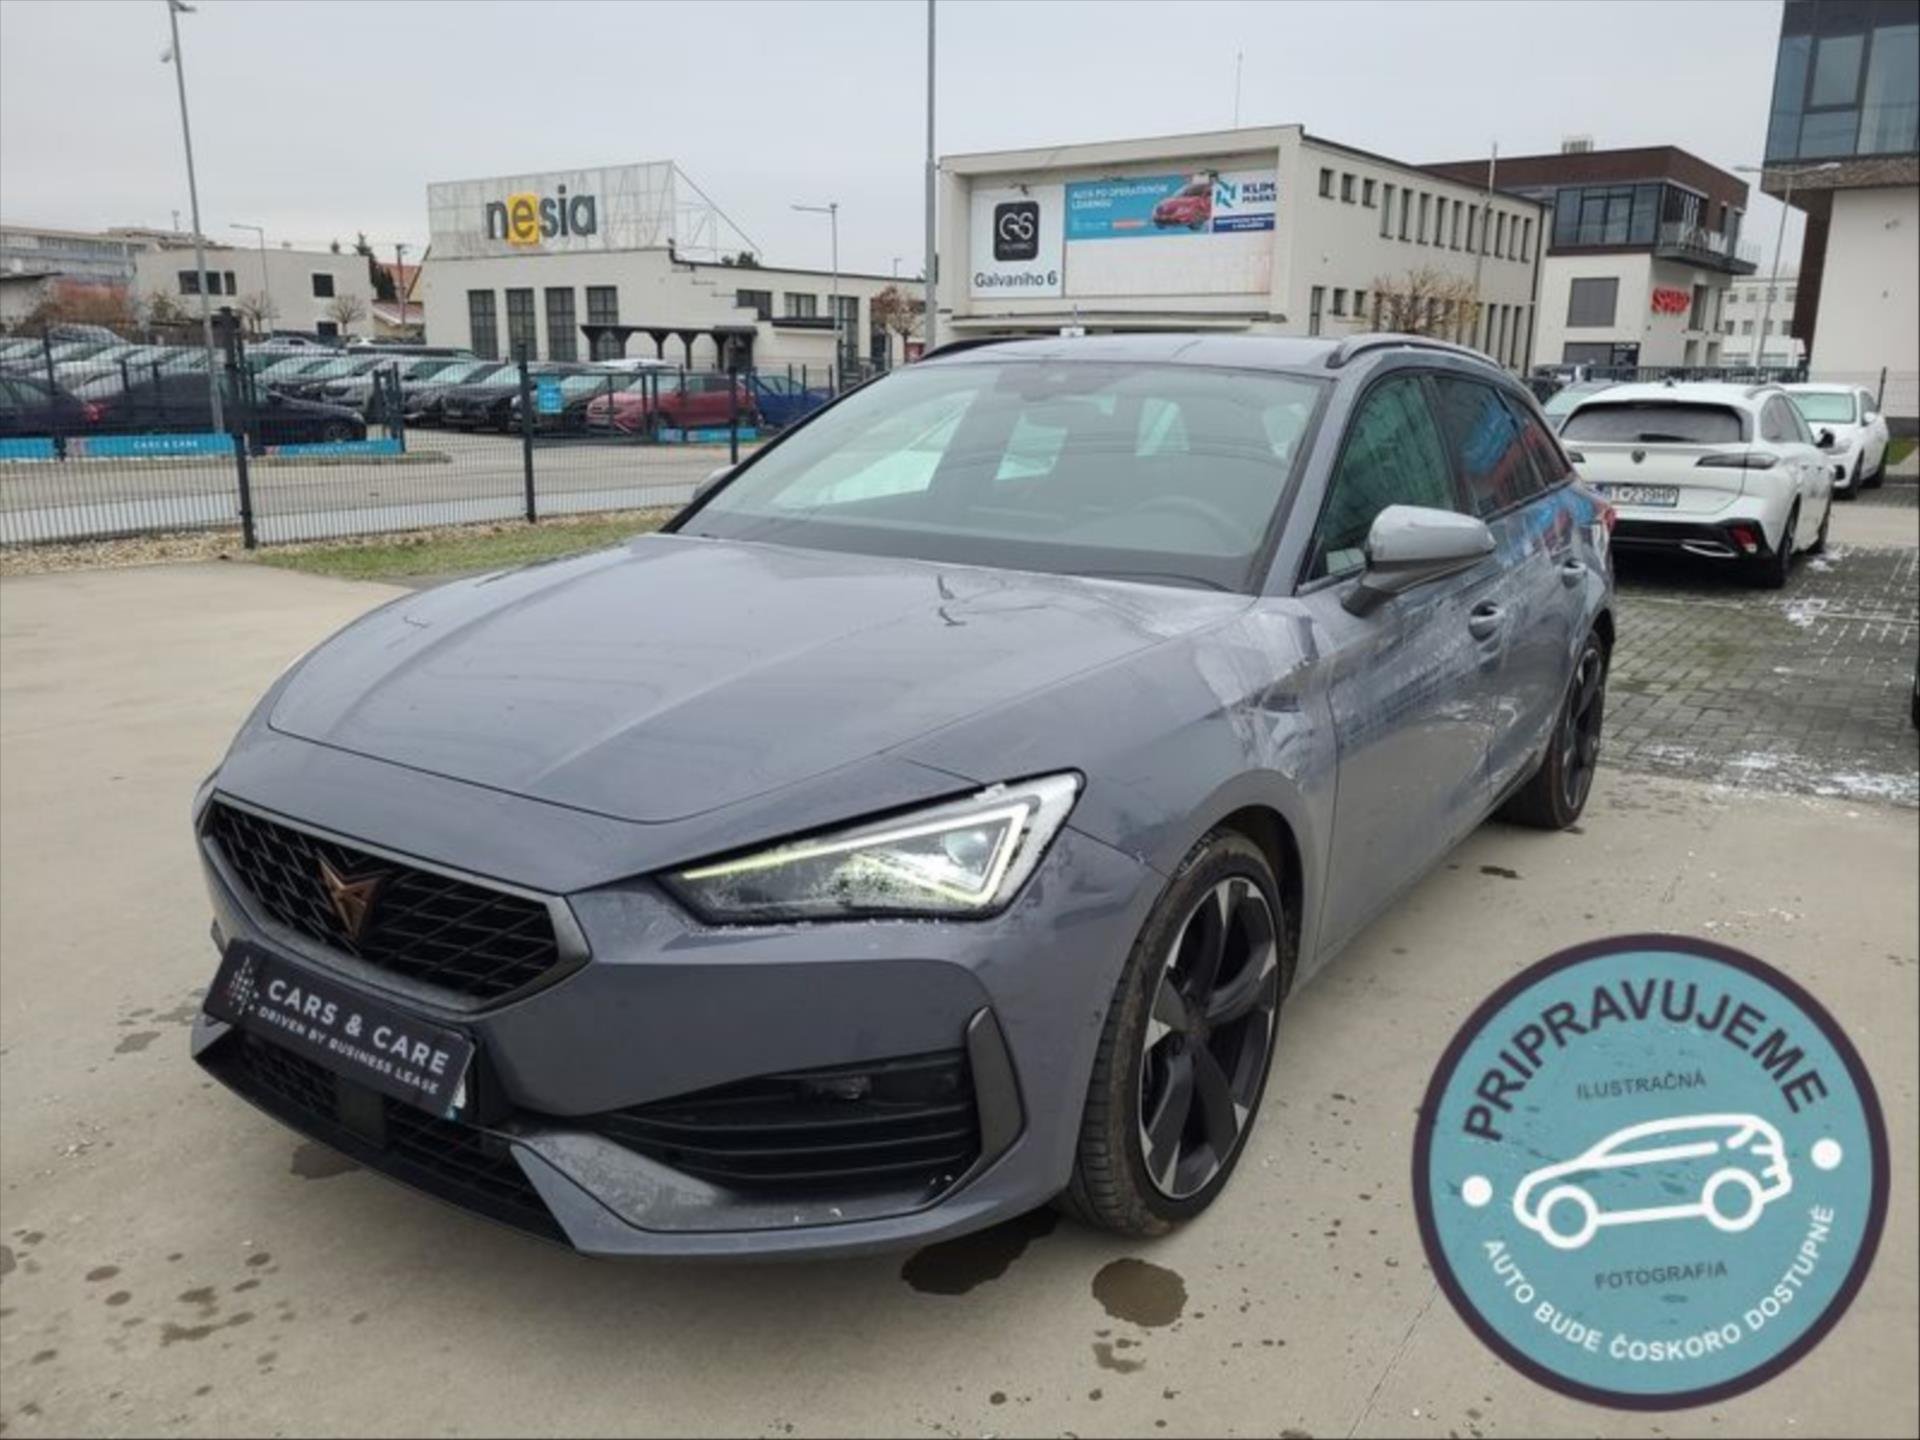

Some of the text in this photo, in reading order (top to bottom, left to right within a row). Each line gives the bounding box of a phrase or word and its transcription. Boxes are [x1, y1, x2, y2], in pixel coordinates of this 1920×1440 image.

[485, 184, 597, 240] nesia
[1000, 212, 1034, 240] GS
[974, 270, 1058, 288] Galvaniho 6
[258, 1006, 440, 1095] DRIVEN BY BUSINESS LEASE
[268, 979, 449, 1075] CARS & CARE
